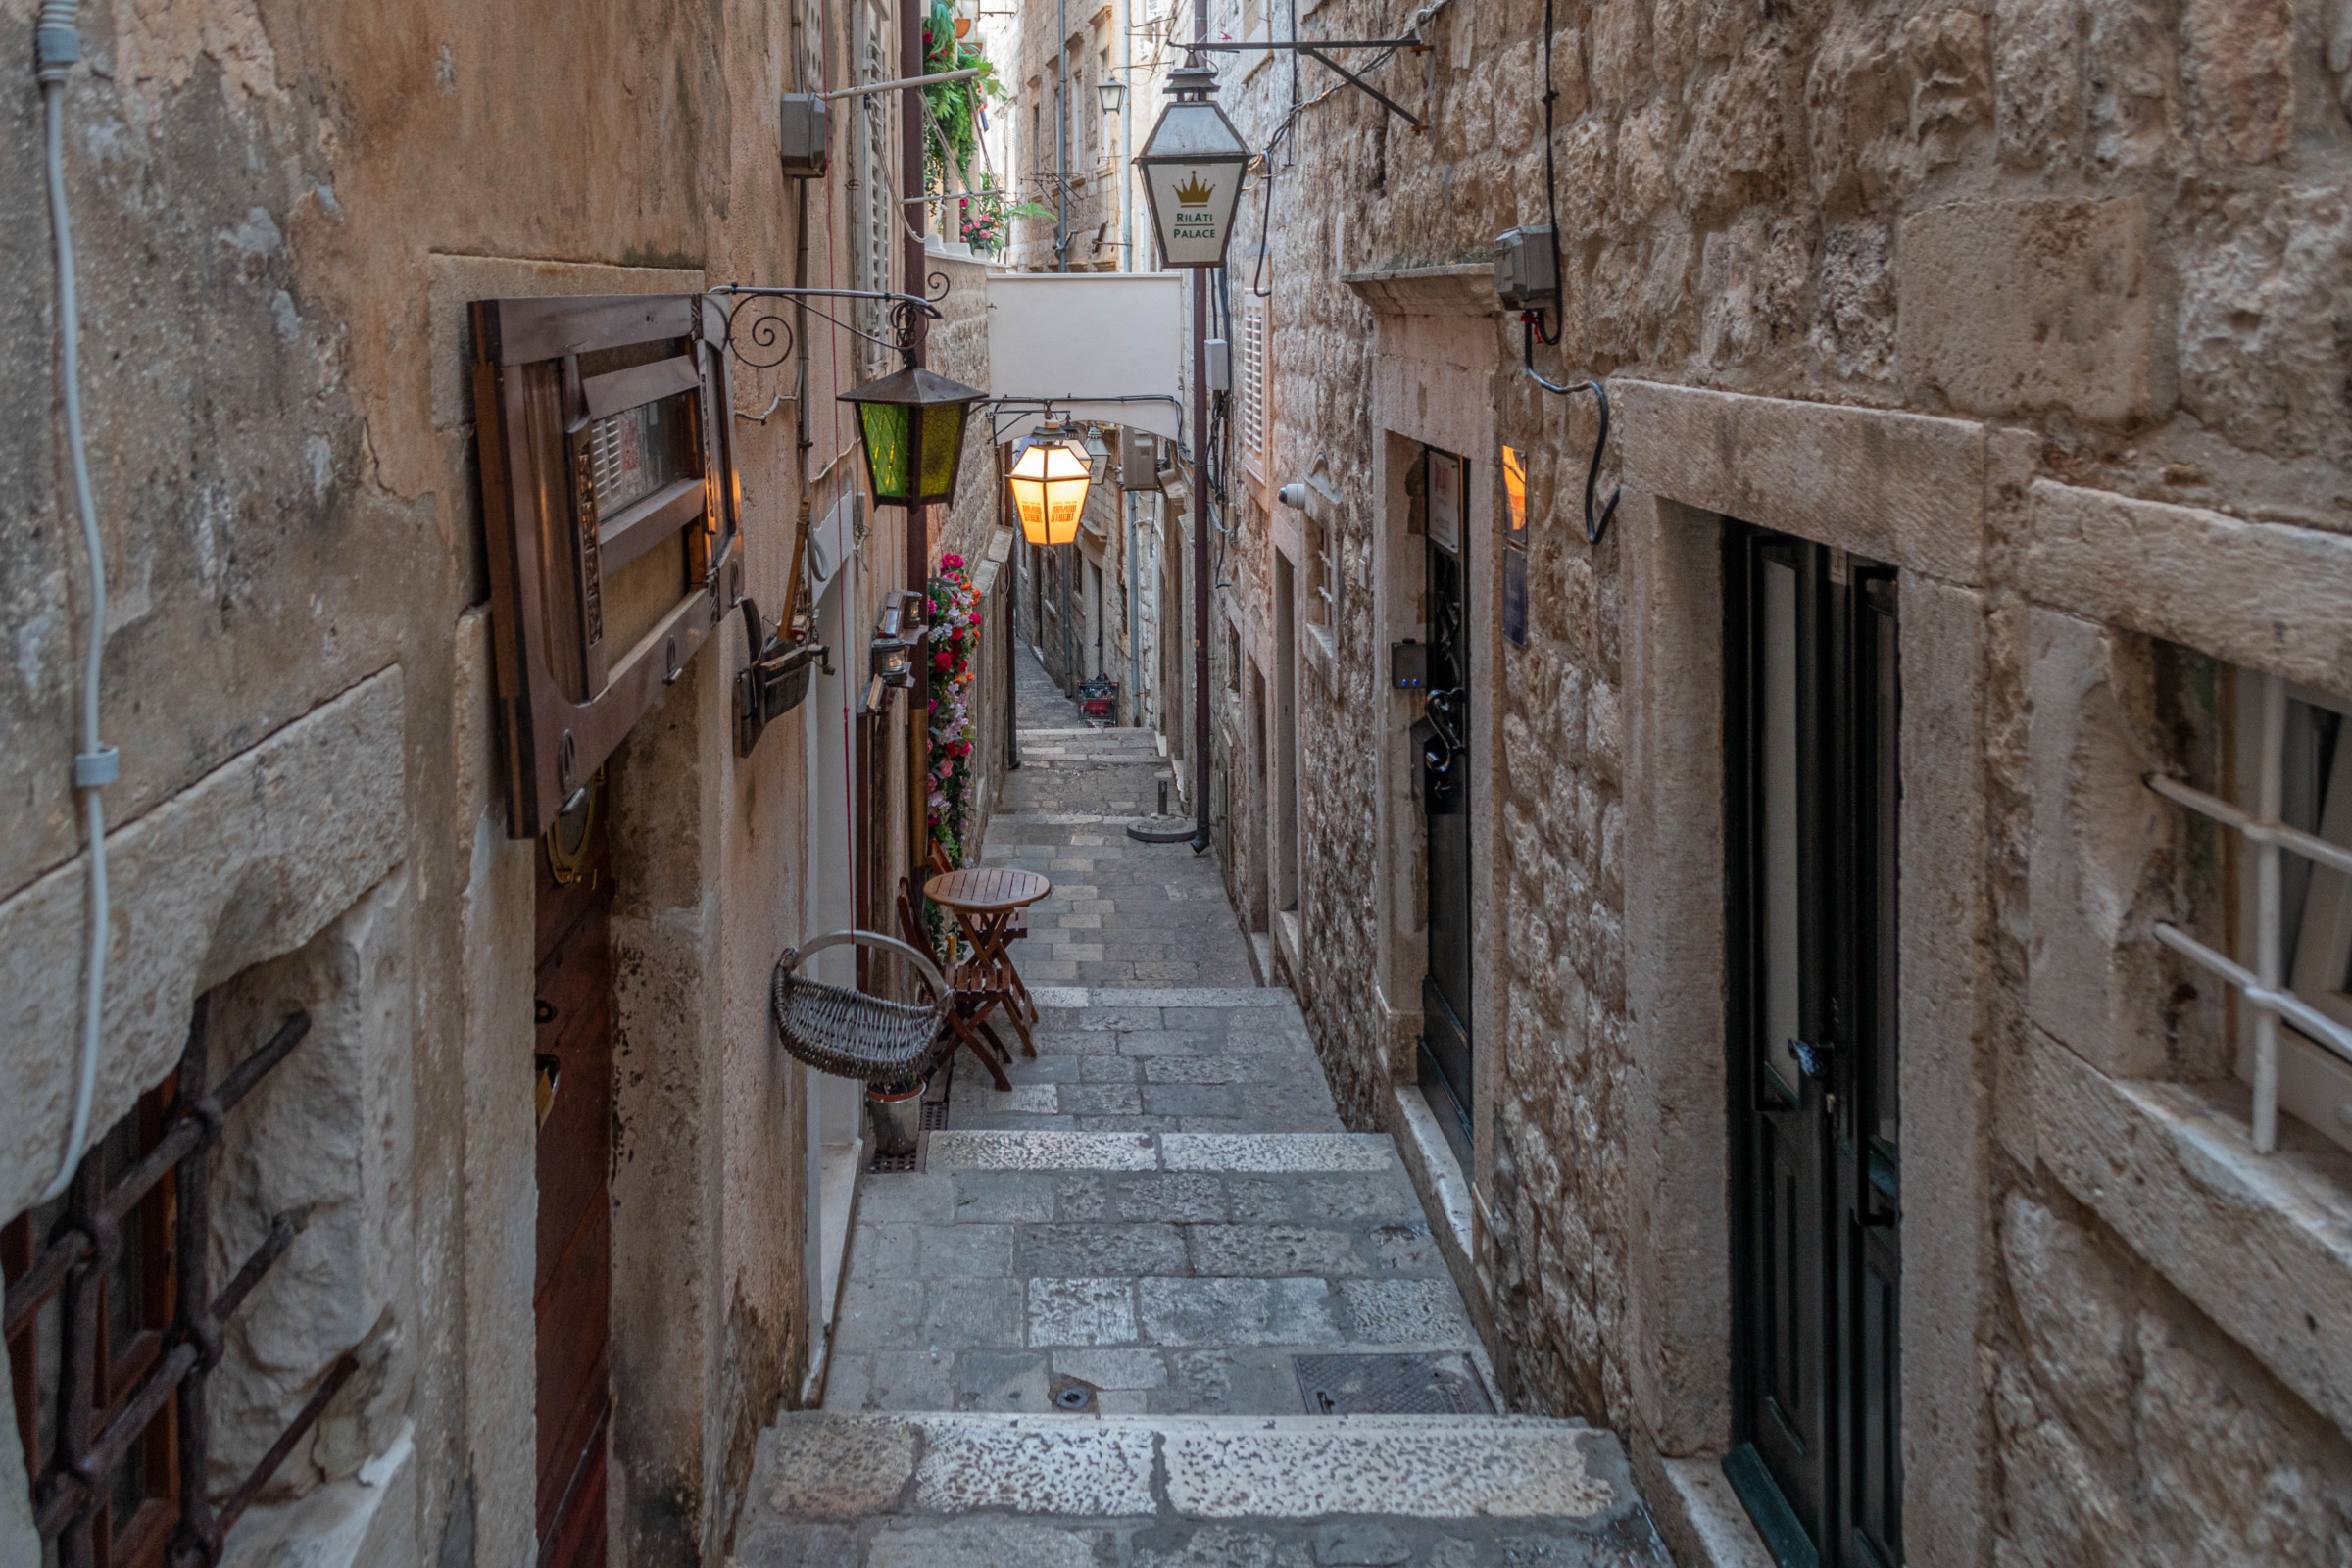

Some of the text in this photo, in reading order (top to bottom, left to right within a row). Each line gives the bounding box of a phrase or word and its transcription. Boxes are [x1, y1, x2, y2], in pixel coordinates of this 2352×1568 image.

[1176, 213, 1213, 222] RILATI
[1173, 228, 1216, 239] PALACE
[1050, 512, 1074, 523] STREET
